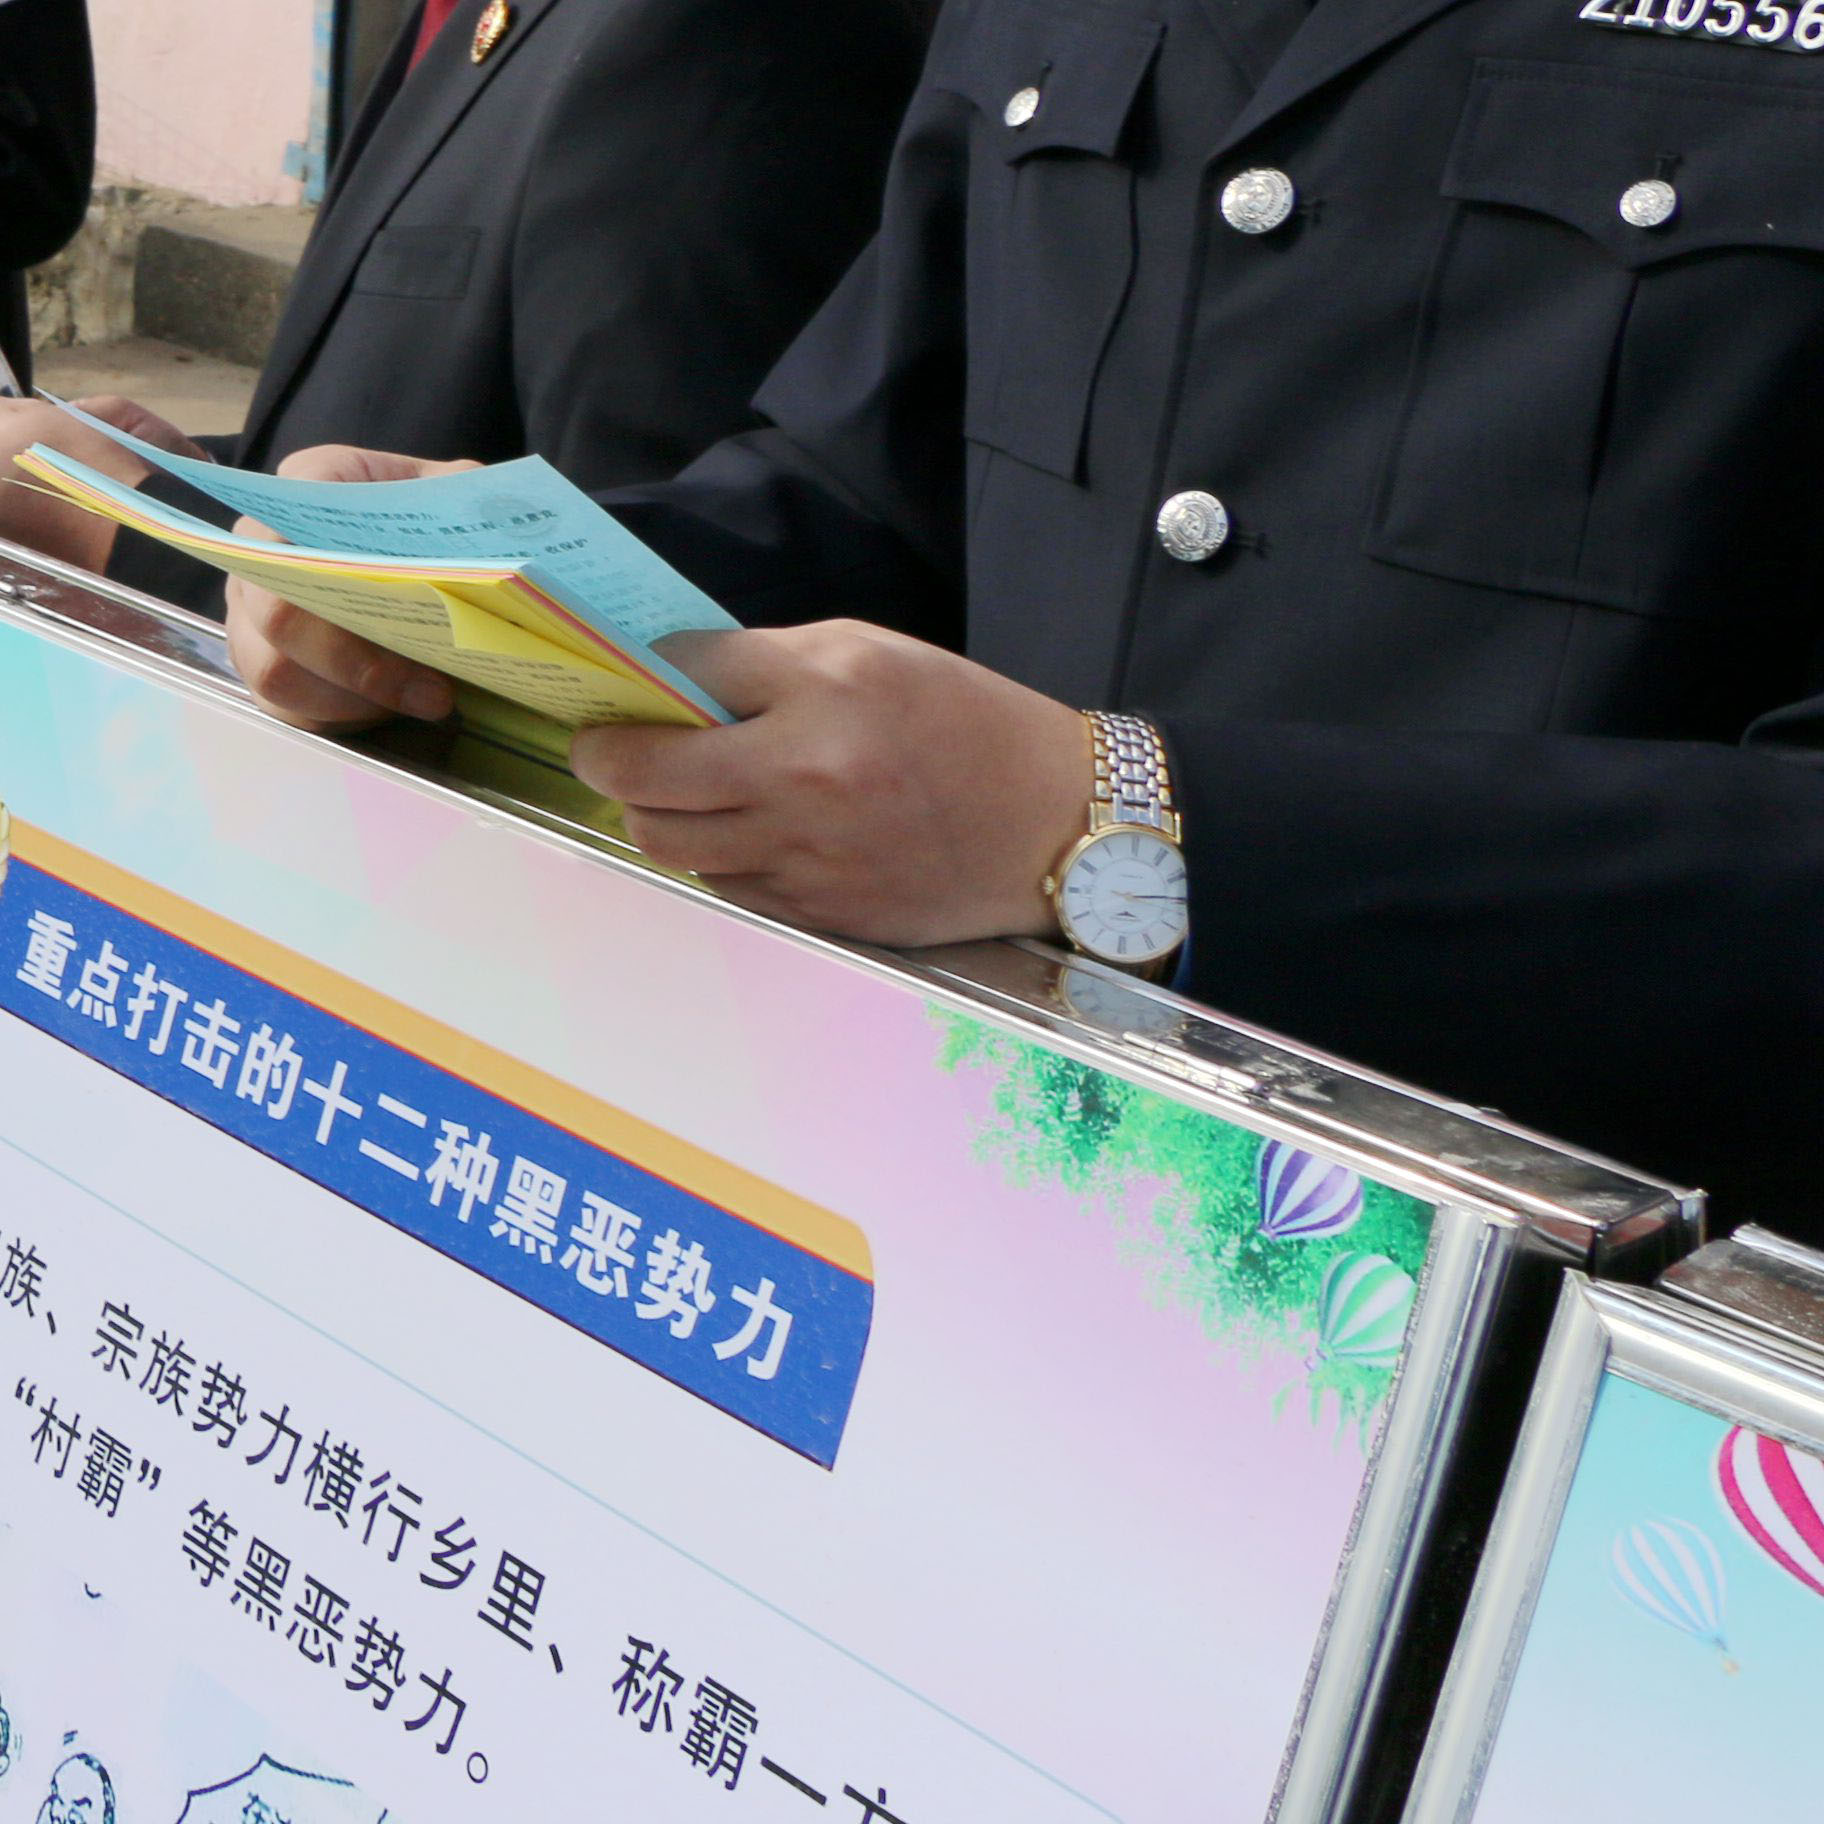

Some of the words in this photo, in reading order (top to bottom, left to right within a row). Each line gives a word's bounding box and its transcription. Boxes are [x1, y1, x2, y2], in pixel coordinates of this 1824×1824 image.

[14, 910, 797, 1383] 重点打击的十二种黑恶势力
